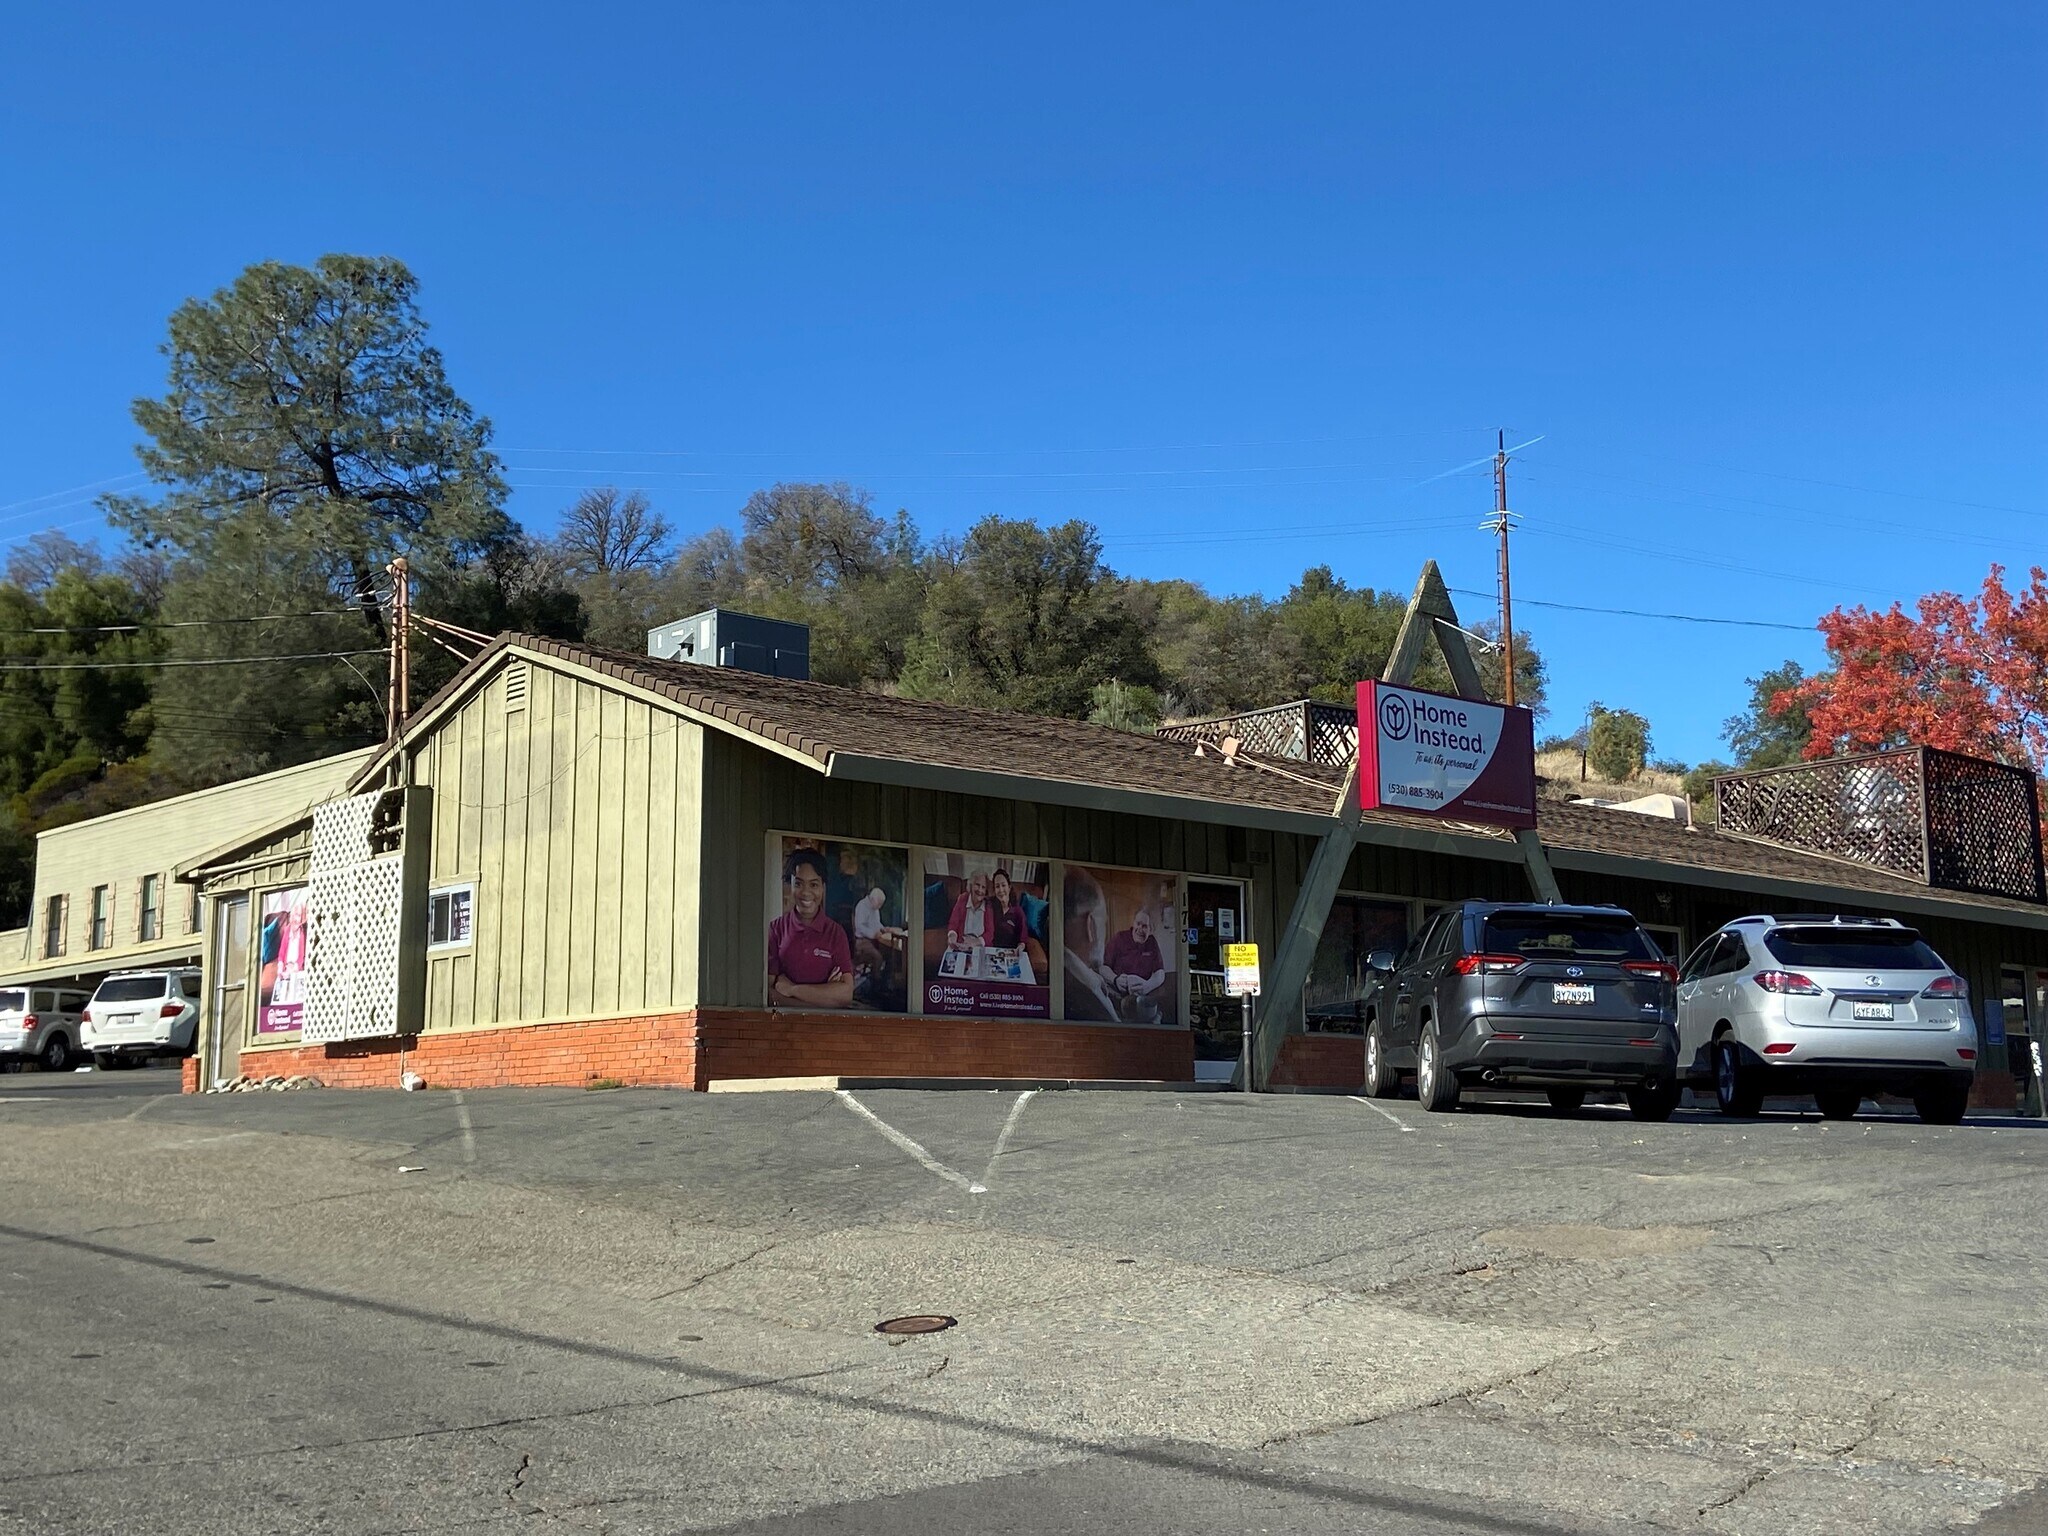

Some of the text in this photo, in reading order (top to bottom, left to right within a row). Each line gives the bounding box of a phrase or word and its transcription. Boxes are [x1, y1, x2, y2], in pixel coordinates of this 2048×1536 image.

[1413, 698, 1467, 728] Home
[1414, 722, 1486, 755] Instead.
[1415, 751, 1424, 764] To
[1443, 758, 1478, 771] personal
[1388, 783, 1444, 800] (530) 885-3904
[944, 985, 968, 996] Home
[1555, 990, 1591, 1001] 8YZN991
[944, 995, 974, 1005] Instead
[1856, 1007, 1891, 1018] 6YFA843
